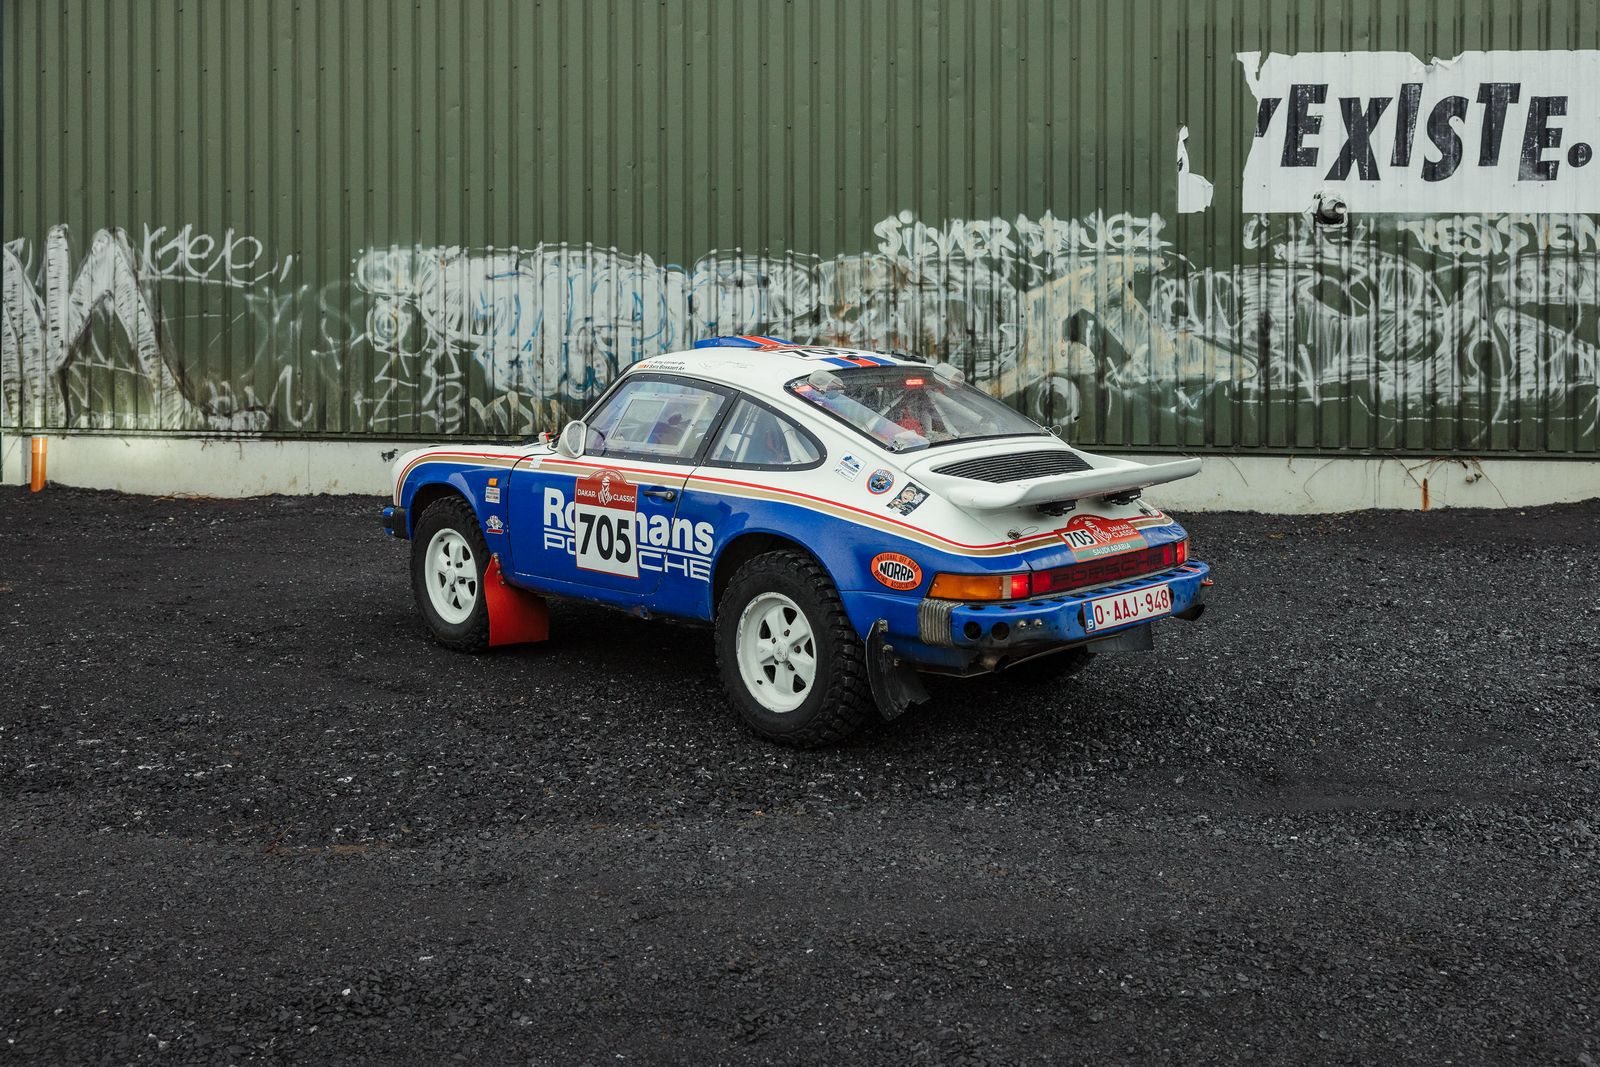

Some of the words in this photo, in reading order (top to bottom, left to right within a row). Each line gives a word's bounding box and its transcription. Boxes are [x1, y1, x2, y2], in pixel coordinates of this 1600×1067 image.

[577, 488, 597, 498] DAKAR
[612, 493, 635, 503] CLASSIC
[1108, 523, 1132, 533] DAKAR
[1112, 529, 1138, 538] CLASSIC
[579, 513, 631, 563] 705
[1064, 530, 1095, 548] 705
[1092, 545, 1111, 556] SAUDI
[1110, 542, 1132, 553] ARABIA
[879, 561, 914, 581] NORRA
[1052, 553, 1163, 583] PORSCHE
